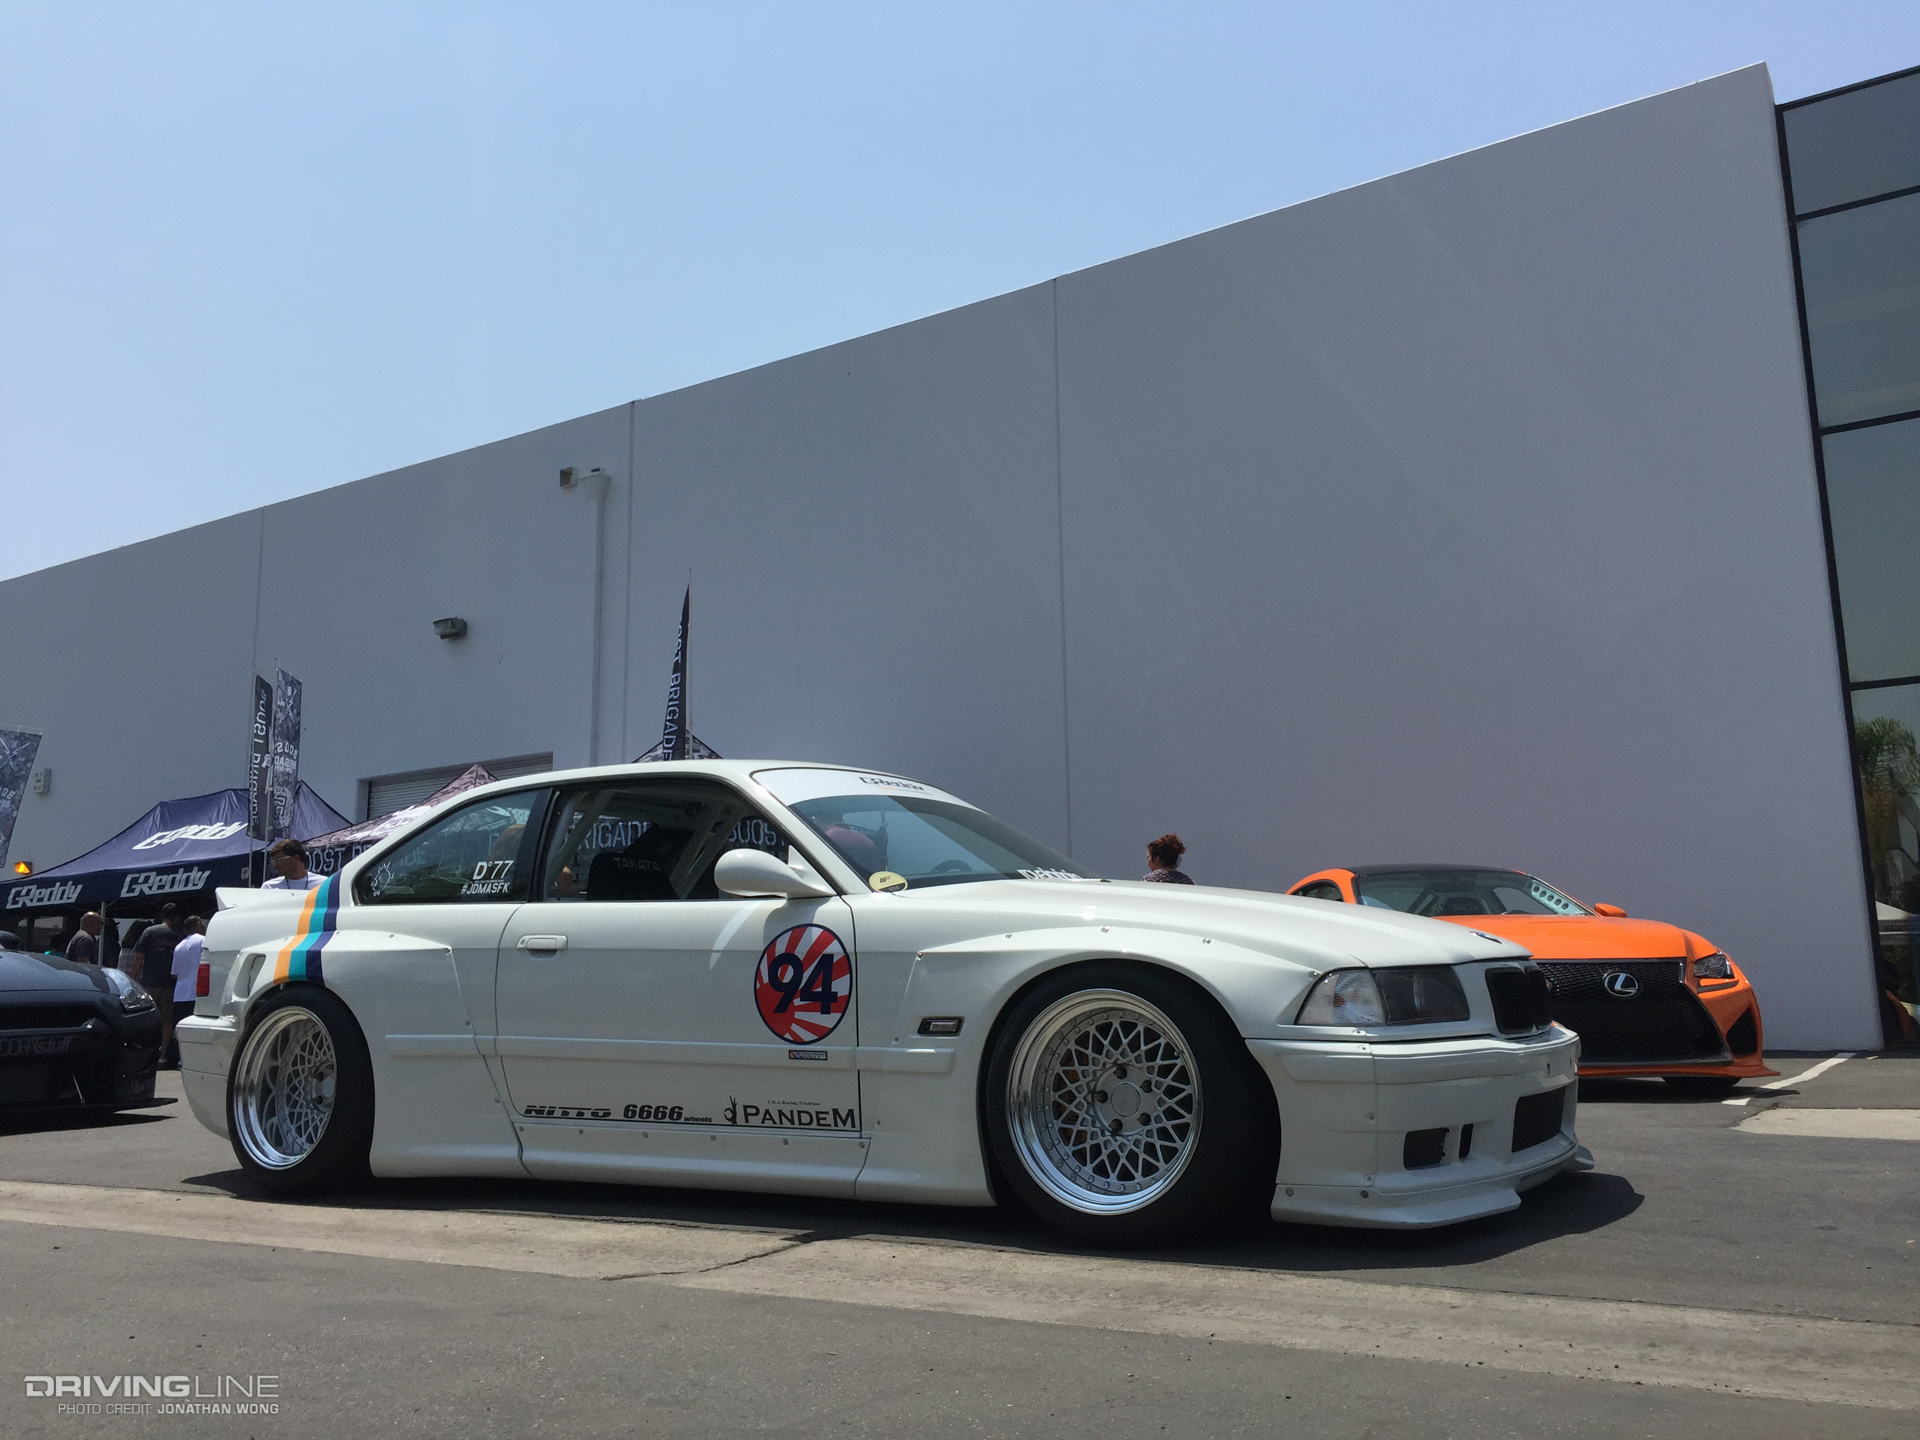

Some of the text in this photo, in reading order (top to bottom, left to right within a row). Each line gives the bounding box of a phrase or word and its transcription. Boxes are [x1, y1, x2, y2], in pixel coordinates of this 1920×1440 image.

[662, 672, 681, 761] BRIGADE
[613, 857, 661, 873] TAKATA
[5, 880, 83, 909] GReddy
[120, 866, 212, 898] GReddy
[460, 881, 511, 895] #JDMASFK
[767, 952, 839, 1015] 94
[523, 1104, 713, 1123] NITTO 6666 wheels
[742, 1104, 858, 1129] PANDEM
